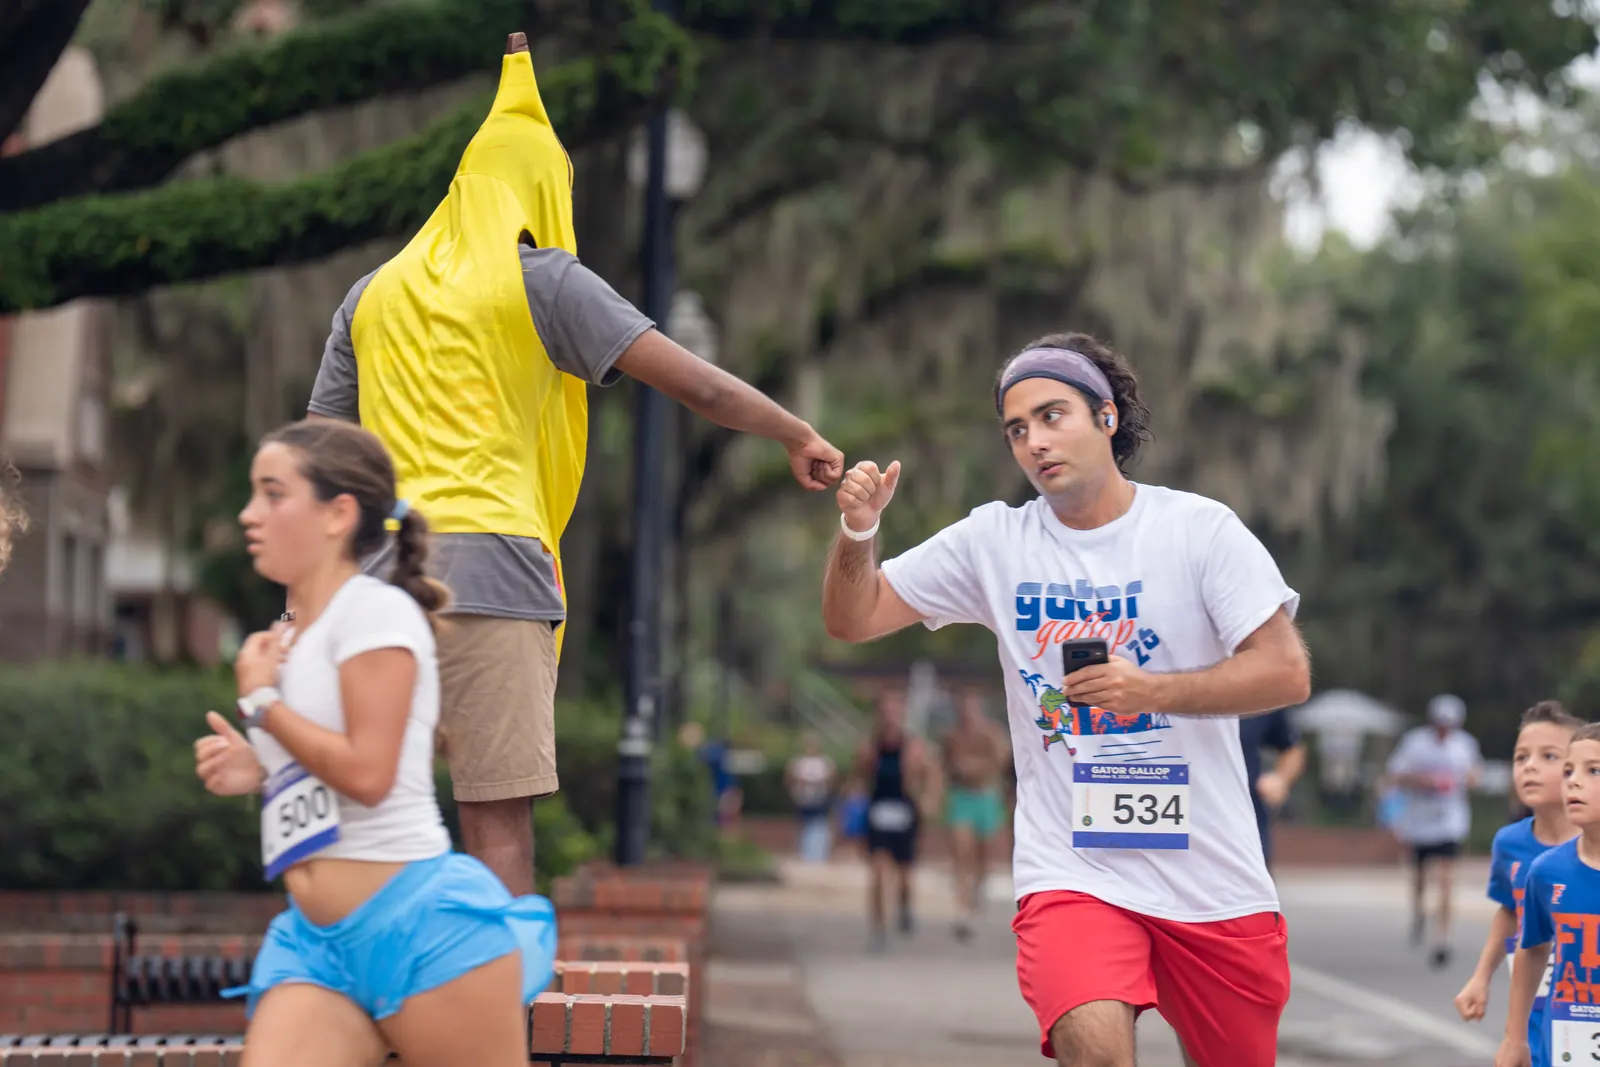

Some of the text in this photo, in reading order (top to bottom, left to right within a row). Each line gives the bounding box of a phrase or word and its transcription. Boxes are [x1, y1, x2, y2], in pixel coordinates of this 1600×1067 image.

[1016, 579, 1143, 631] gator
[1126, 628, 1160, 666] 26
[1091, 766, 1170, 776] GATOR GALLOP
[280, 785, 330, 838] 500
[1113, 793, 1184, 825] 534
